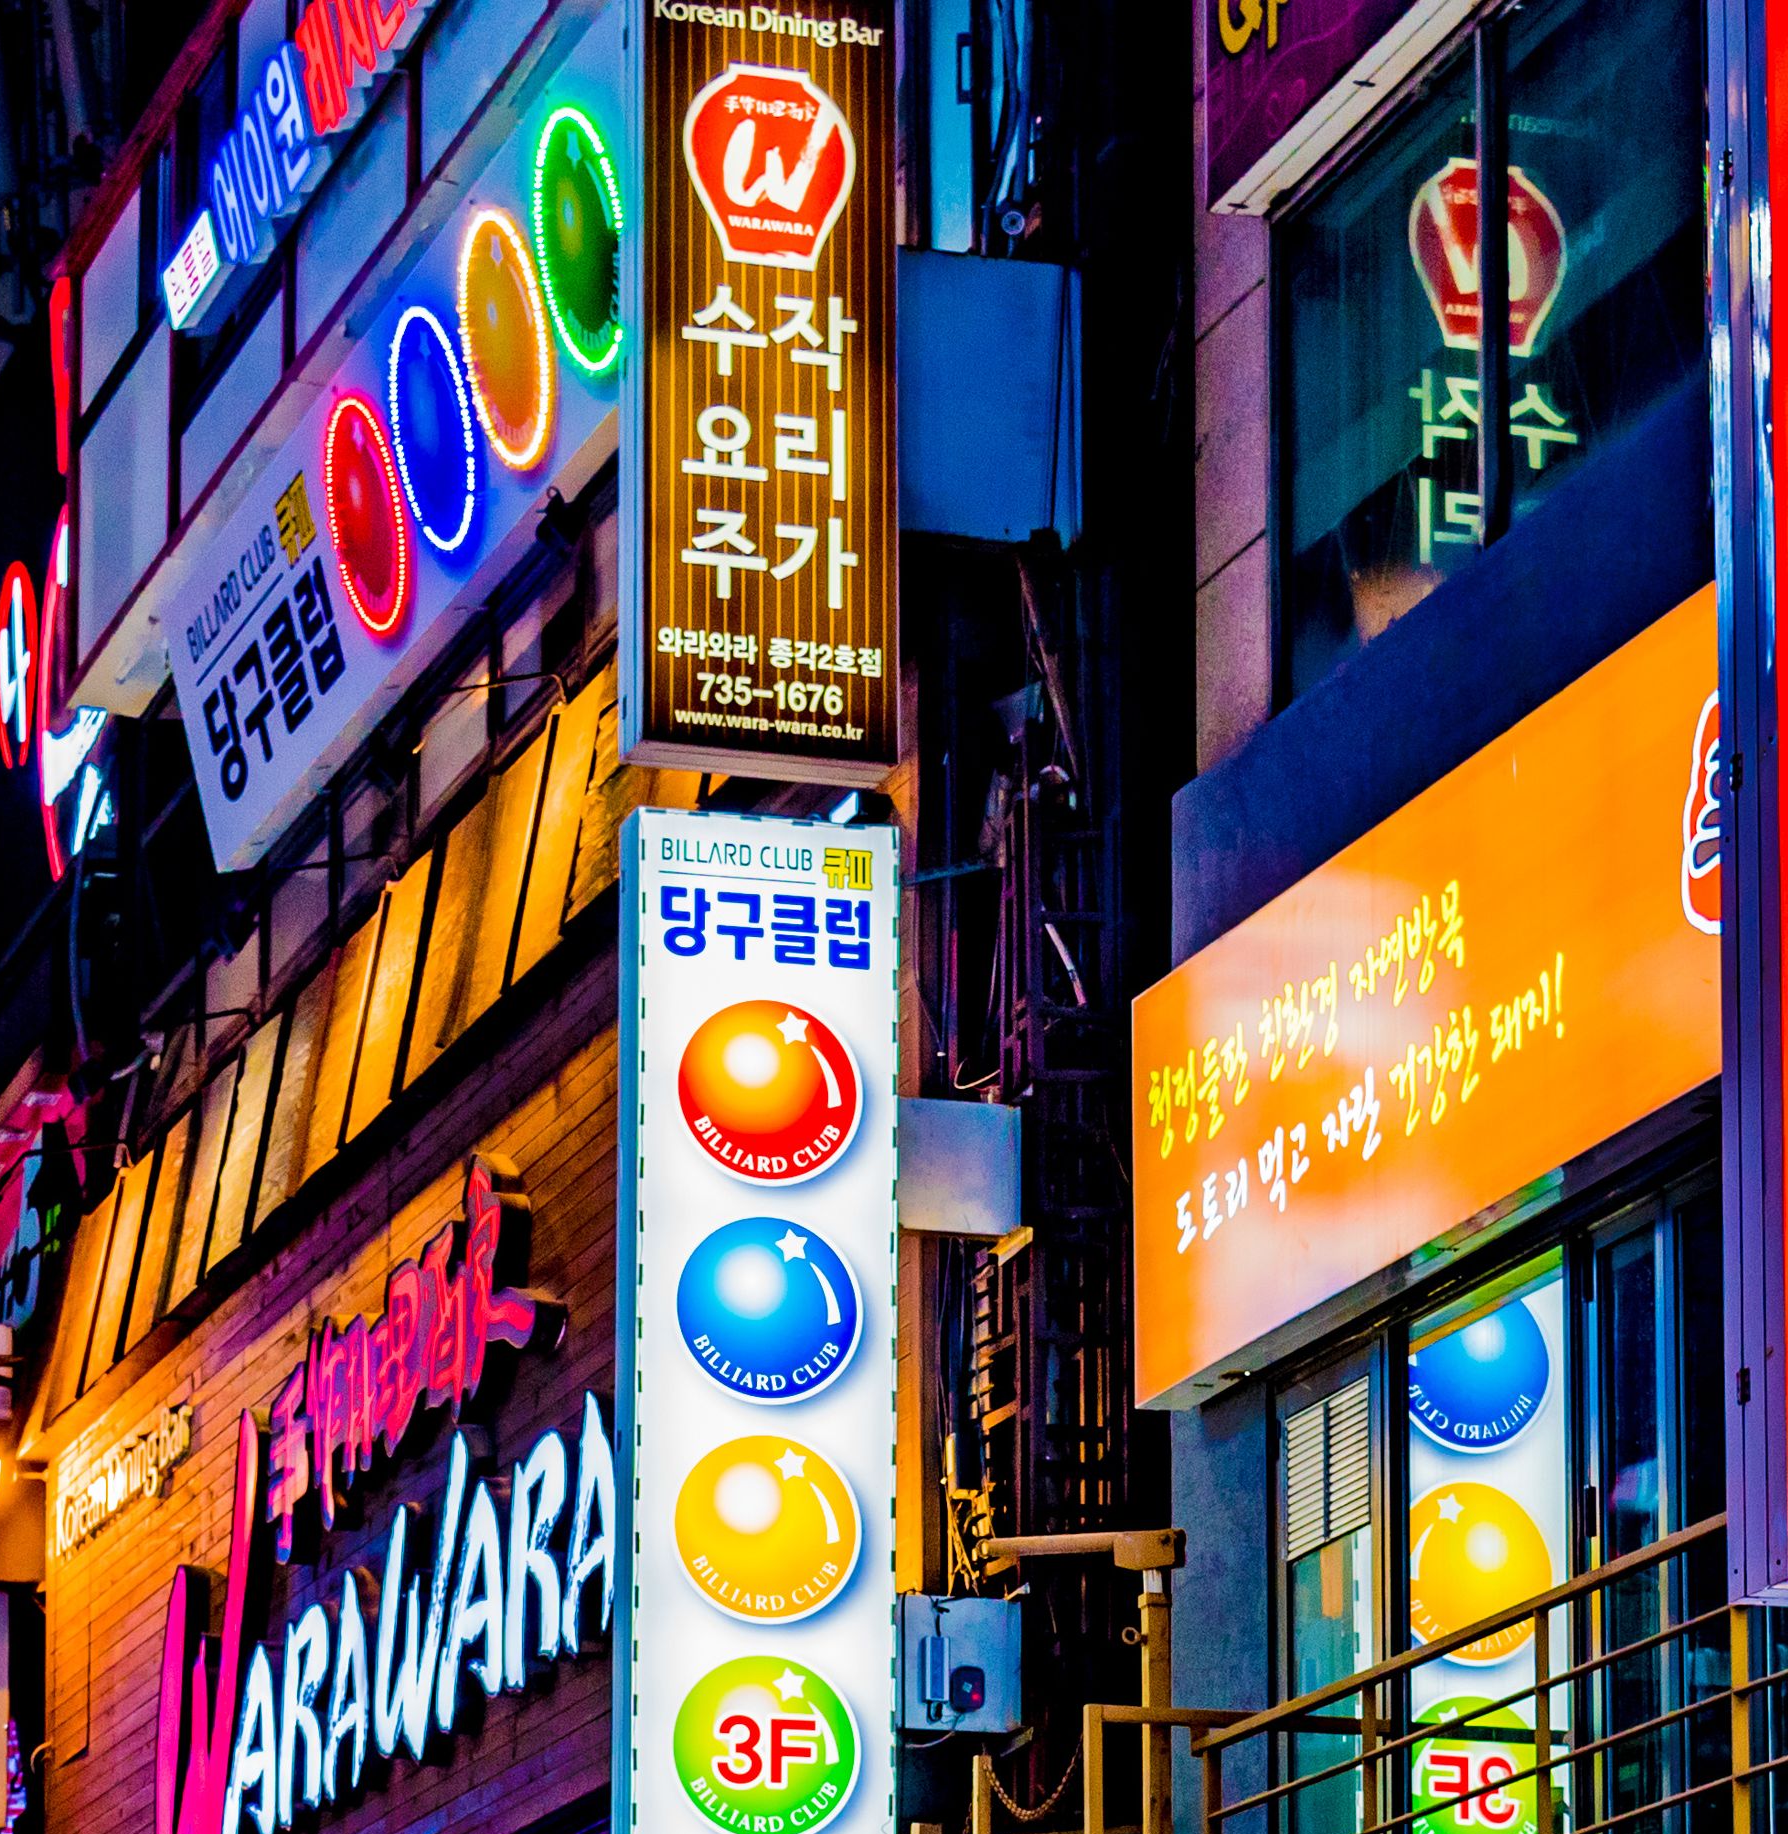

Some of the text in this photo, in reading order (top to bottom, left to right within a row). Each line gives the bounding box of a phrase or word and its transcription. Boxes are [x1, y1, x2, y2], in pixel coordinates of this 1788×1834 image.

[654, 0, 884, 48] Korean Dining Bar
[728, 214, 815, 237] WARAWARA
[682, 284, 858, 391] 수작
[680, 404, 846, 501] 요리
[239, 523, 277, 593] CLUB
[680, 507, 859, 610] 주가
[202, 554, 347, 803] 당구클럽
[657, 627, 882, 678] 와라와라 종각2호점
[696, 672, 843, 716] 735-1676
[675, 709, 864, 741] www.wara-wara.co.kr
[661, 837, 814, 872] BILLARD CLUB
[660, 885, 872, 971] 당구클럽
[1258, 879, 1466, 1081] 친환경 자연방목
[1175, 951, 1565, 1254] 도토리 먹고 자란 건강한 돼지!
[693, 1114, 842, 1175] BILLIARD CLUB
[692, 1333, 840, 1392] BILLIARD CLUB
[691, 1554, 839, 1611] BILLIARD CLUB
[716, 1714, 817, 1785] 3F
[689, 1775, 840, 1834] BILLIARD CLUB
